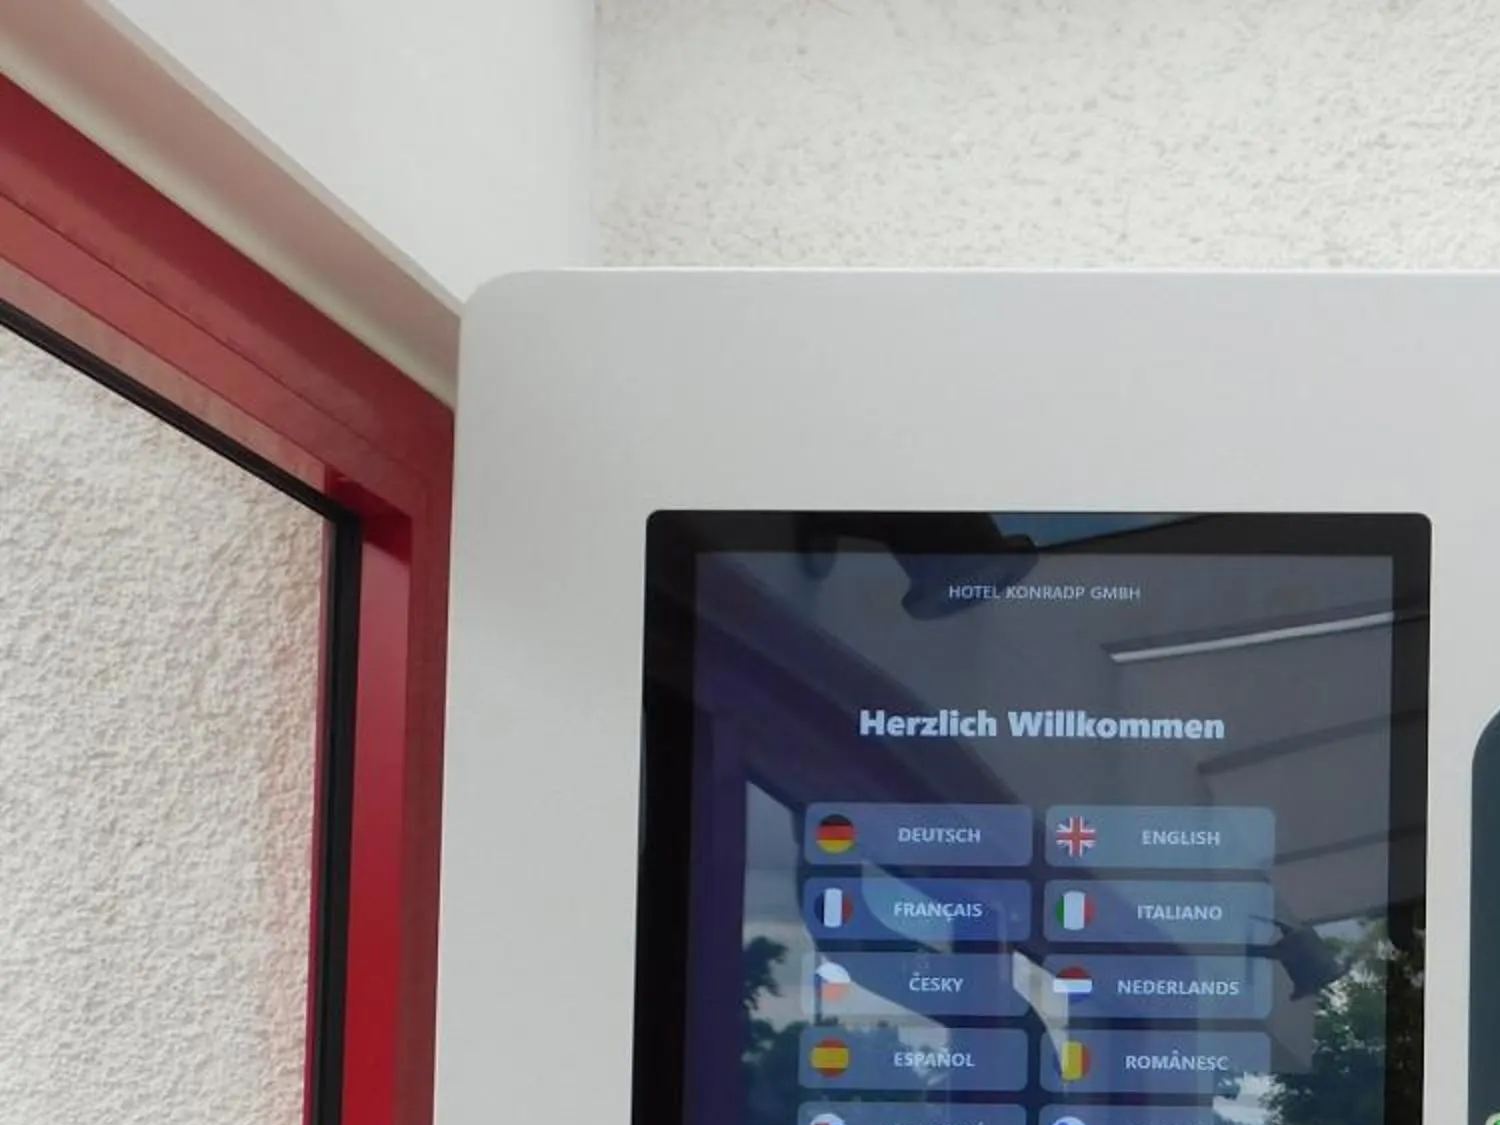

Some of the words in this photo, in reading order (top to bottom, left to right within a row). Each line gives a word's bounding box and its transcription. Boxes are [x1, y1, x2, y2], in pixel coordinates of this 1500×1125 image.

[949, 585, 1000, 600] HOTEL
[1006, 585, 1085, 601] KONRADP
[1090, 586, 1141, 601] GMBH
[859, 708, 997, 738] Herzlich
[1008, 710, 1225, 740] Willkommen
[898, 827, 981, 844] DEUTSCH
[1142, 830, 1220, 846] ENGLISH
[894, 902, 982, 921] FRANÇAIS
[1138, 905, 1222, 921] ITALIANO
[909, 972, 964, 992] ČESKY
[1118, 979, 1239, 996] NEDERLANDS
[894, 1047, 975, 1068] ESPAÑOL
[1126, 1051, 1229, 1071] ROMÂNESC
